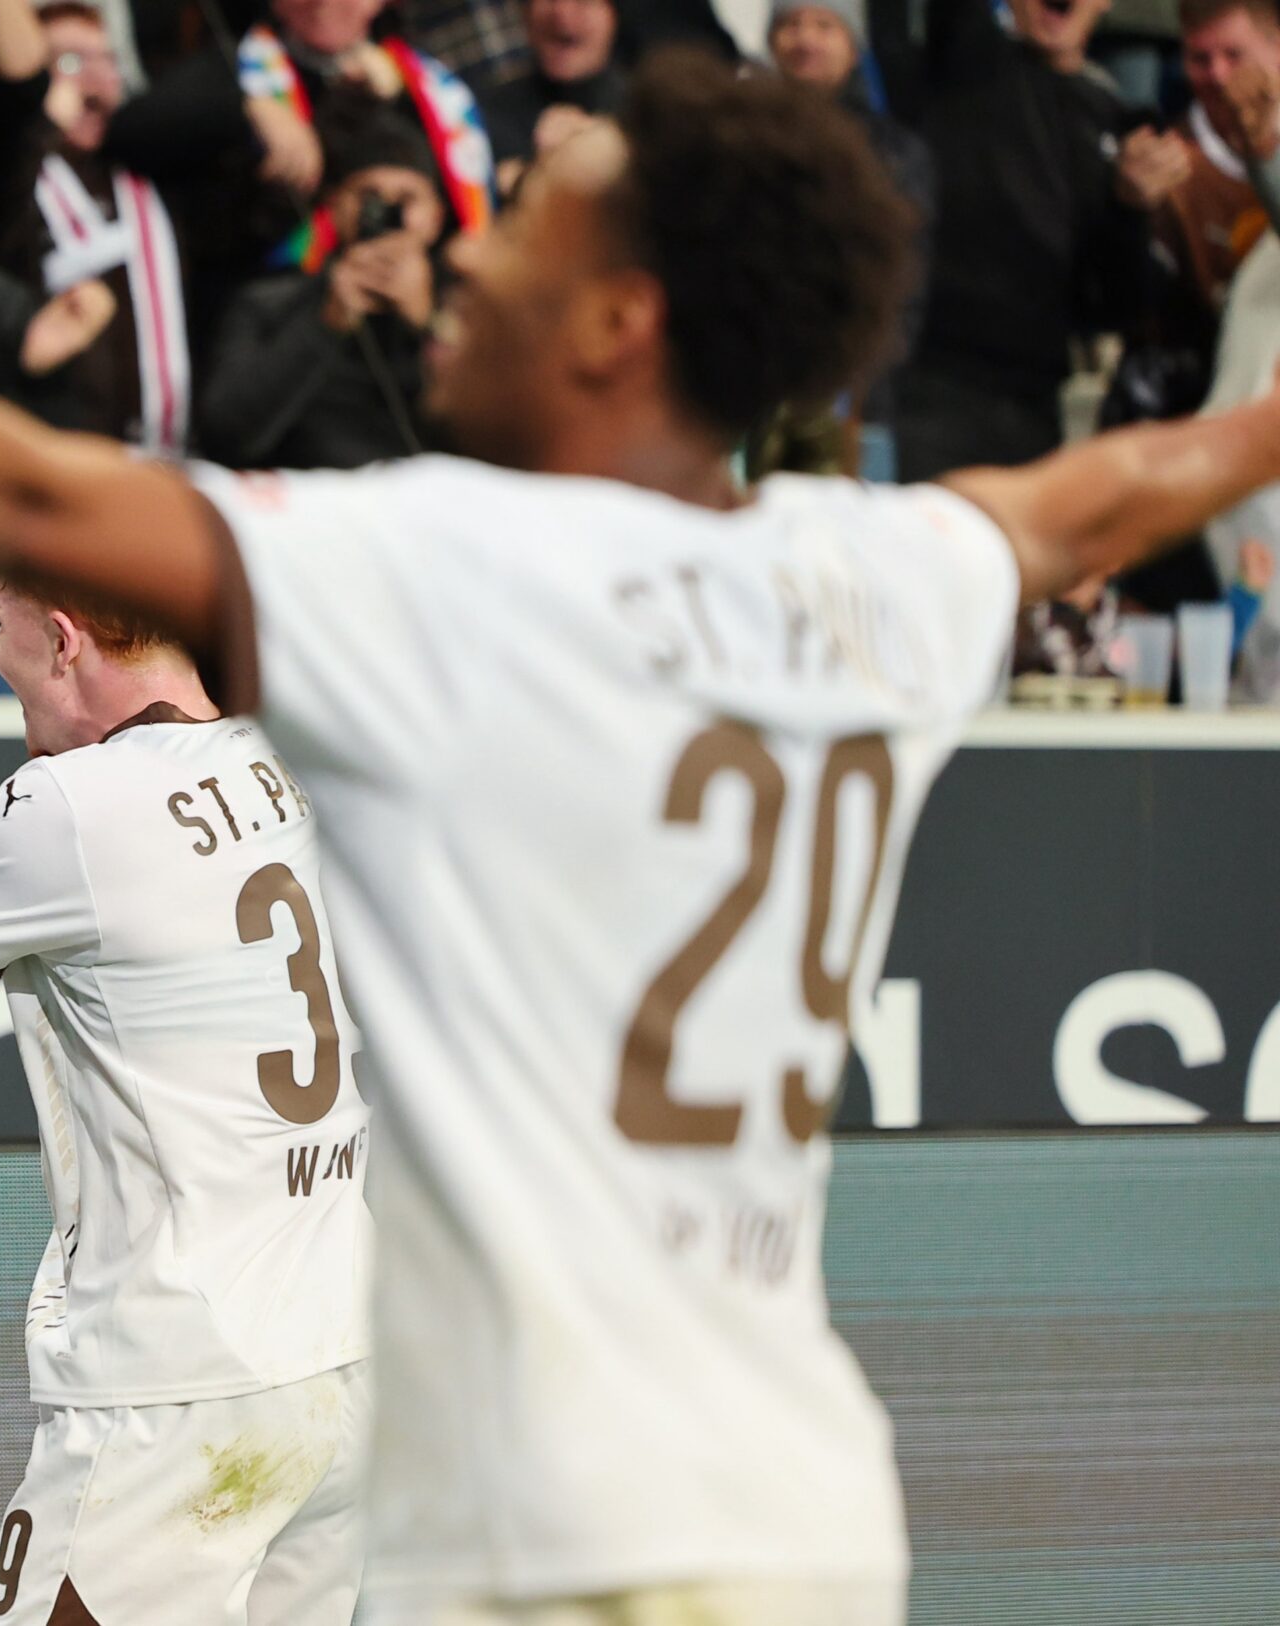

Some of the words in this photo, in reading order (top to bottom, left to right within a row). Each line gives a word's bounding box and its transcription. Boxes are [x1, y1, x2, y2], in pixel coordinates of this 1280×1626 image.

[168, 777, 260, 856] ST.
[249, 755, 313, 823] PA
[614, 714, 894, 1145] 29
[236, 863, 372, 1124] 3
